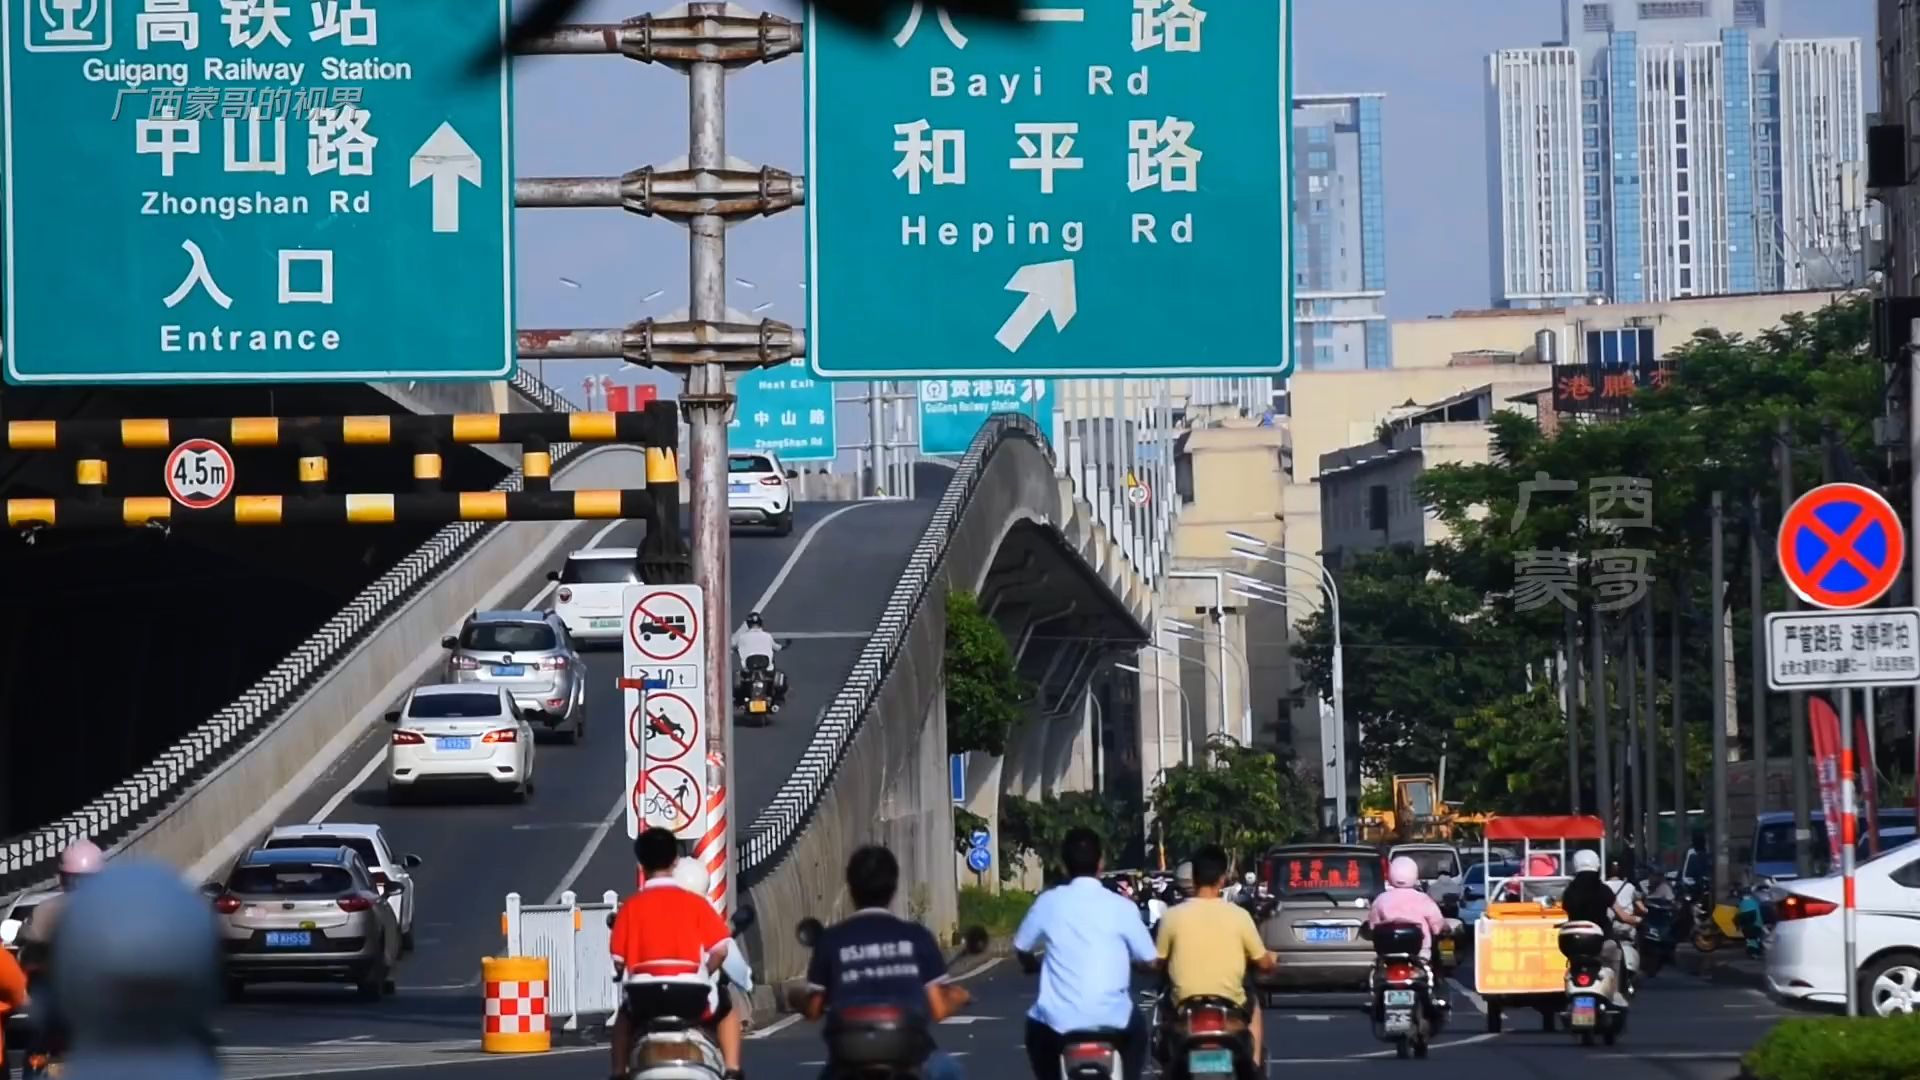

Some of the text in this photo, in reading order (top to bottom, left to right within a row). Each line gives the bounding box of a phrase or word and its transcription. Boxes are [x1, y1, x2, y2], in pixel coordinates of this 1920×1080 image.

[135, 0, 379, 51] 高铁站
[892, 0, 1207, 53] 八一路
[83, 57, 412, 86] Guigang Railway Station
[930, 65, 1149, 104] Bayi Rd
[136, 107, 379, 177] 中山路
[892, 116, 1203, 195] 和平路
[141, 191, 370, 220] Zhongshan Rd
[901, 214, 1194, 252] Heping Rd
[163, 239, 334, 310] 入口
[160, 325, 341, 352] Entrance
[790, 378, 814, 389] Exit
[950, 379, 1016, 398] 贵港站
[754, 408, 825, 428] 中山路
[173, 456, 225, 485] 4.5m
